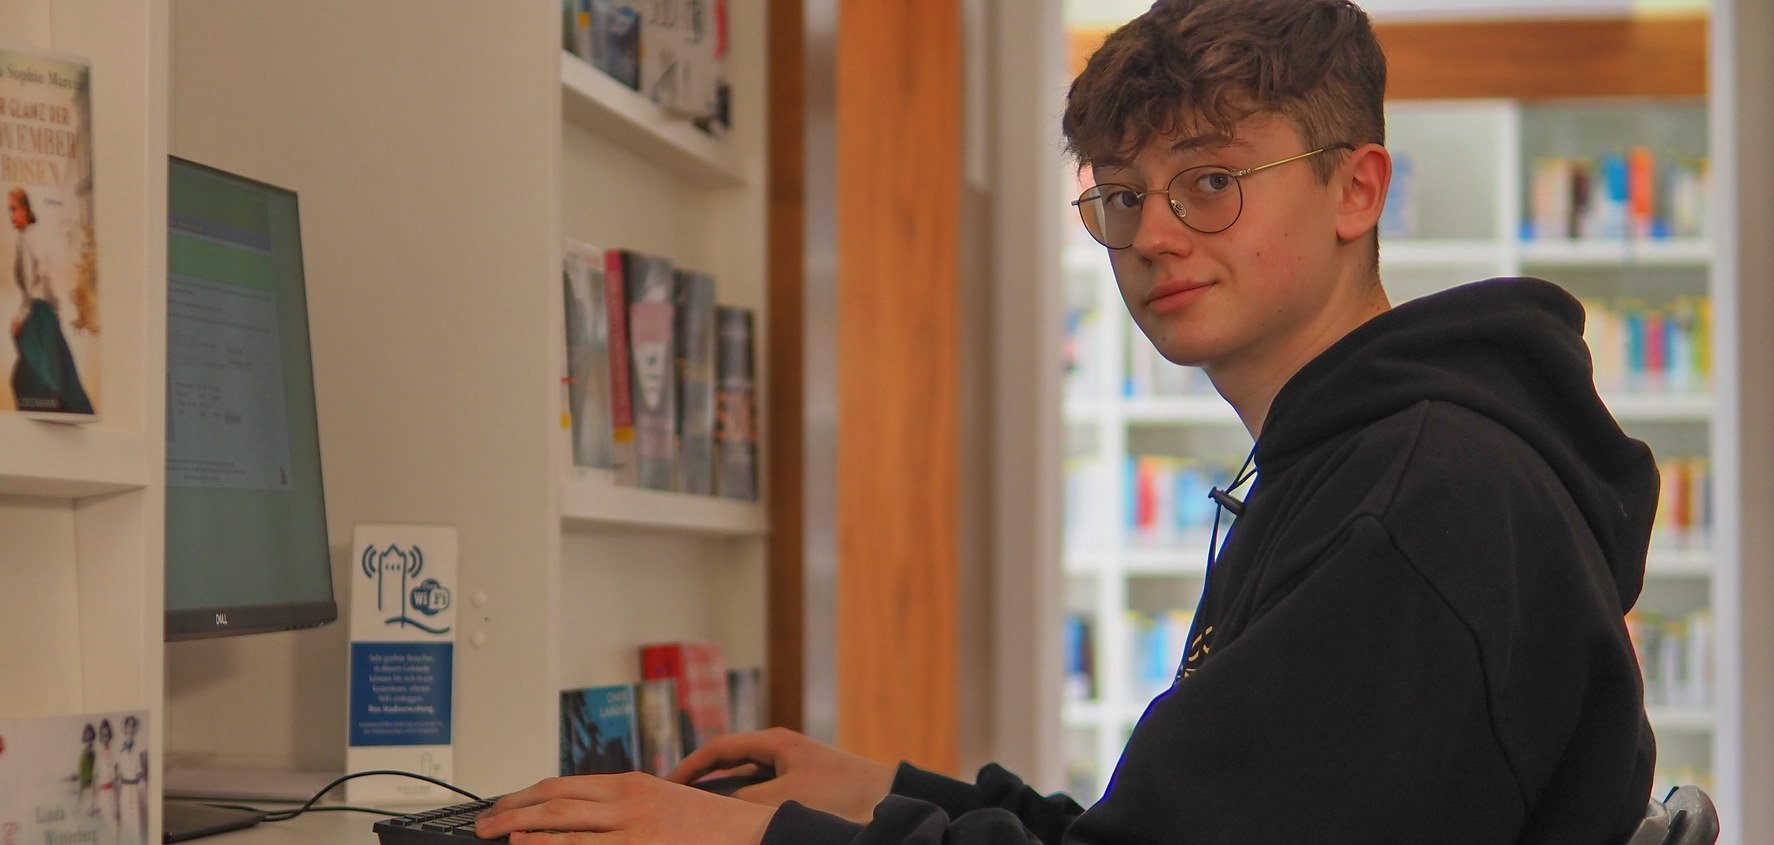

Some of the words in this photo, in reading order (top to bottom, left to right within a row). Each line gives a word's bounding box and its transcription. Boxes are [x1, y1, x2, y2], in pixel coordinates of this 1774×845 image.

[9, 98, 46, 121] GLANZ
[49, 105, 70, 125] DER
[215, 613, 228, 625] DELL
